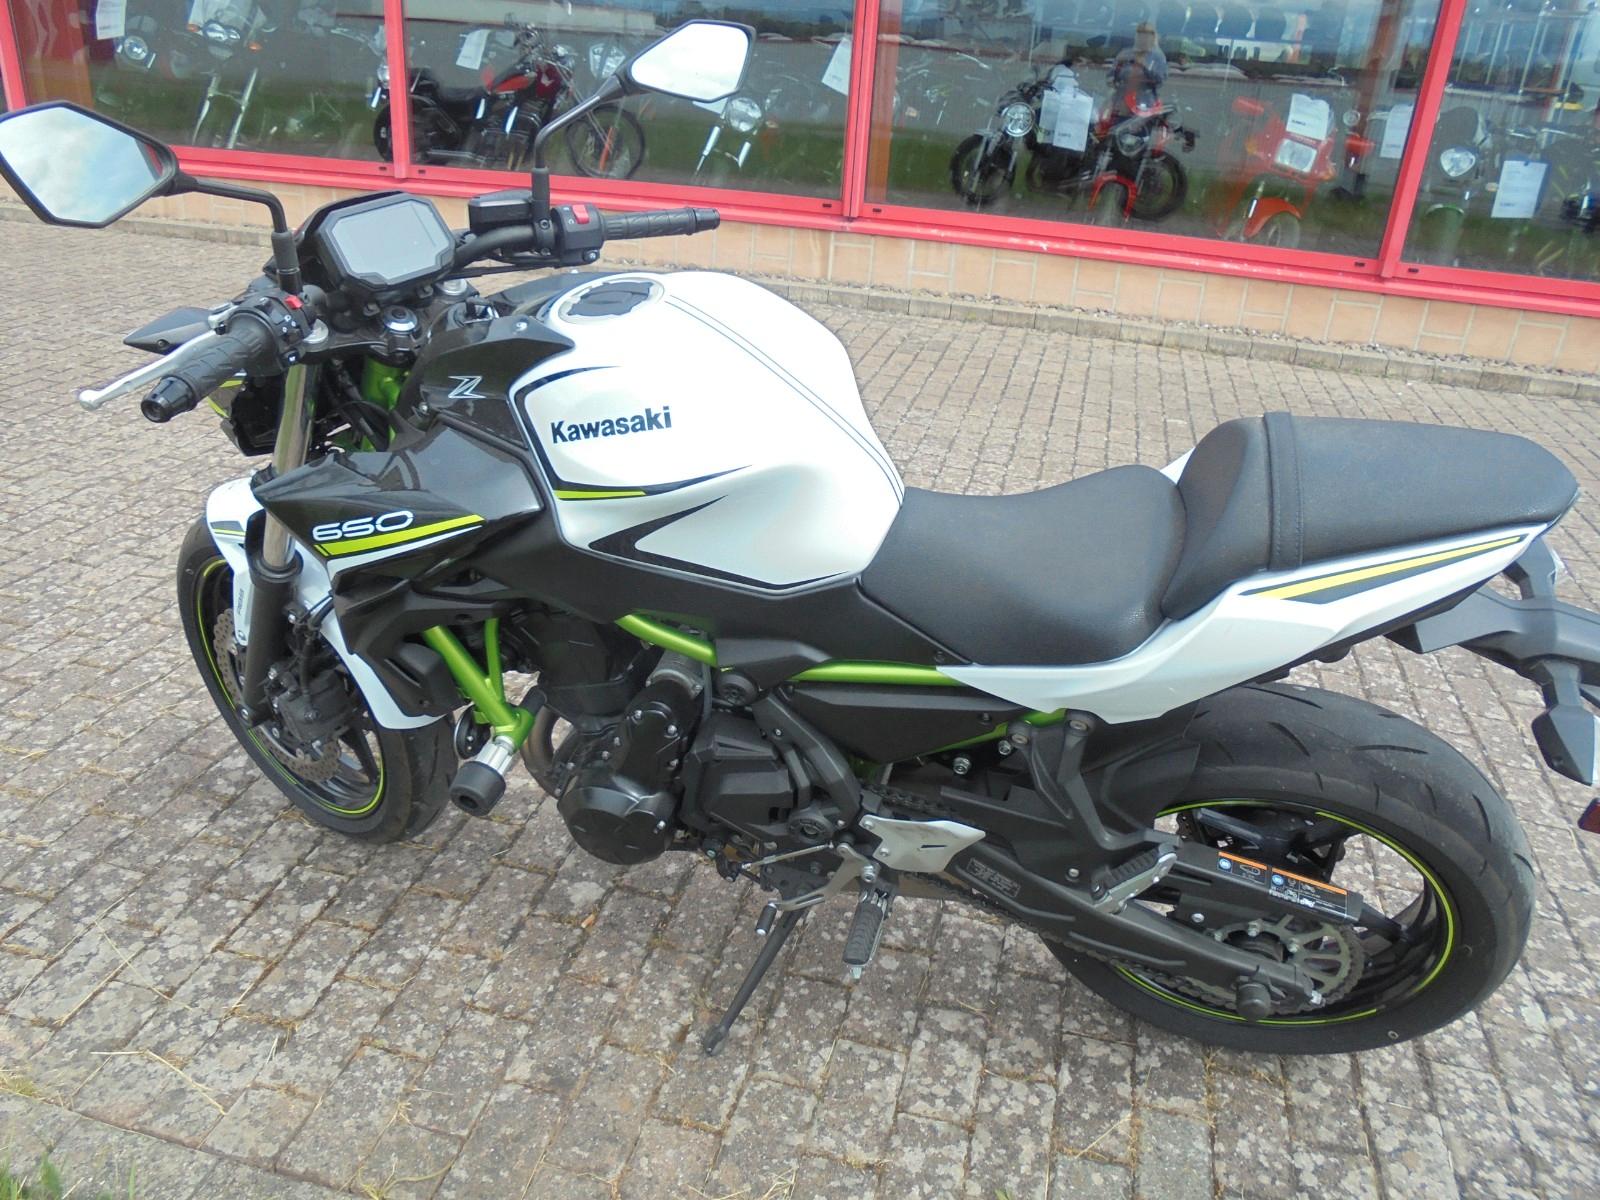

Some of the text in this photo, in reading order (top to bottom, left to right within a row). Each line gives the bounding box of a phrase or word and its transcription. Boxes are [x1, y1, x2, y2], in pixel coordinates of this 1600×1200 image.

[448, 375, 486, 399] Z
[551, 405, 672, 444] Kawasaki
[312, 510, 414, 541] 650
